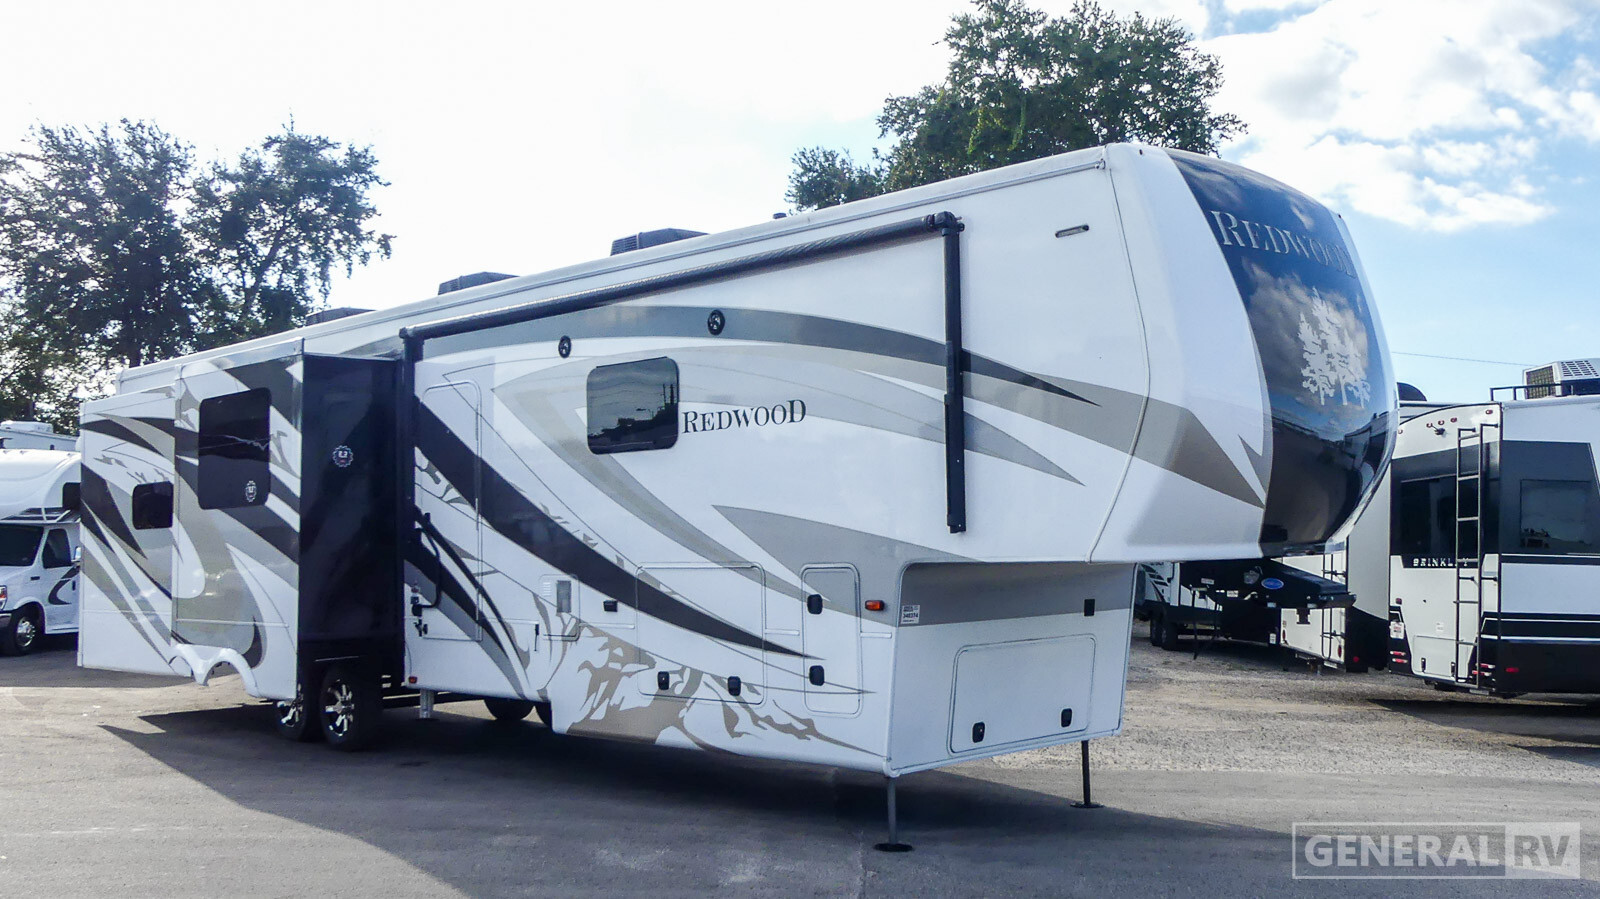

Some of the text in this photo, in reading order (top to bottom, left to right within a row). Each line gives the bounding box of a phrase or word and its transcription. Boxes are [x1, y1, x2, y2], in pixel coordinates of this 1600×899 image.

[1210, 210, 1357, 279] REDWOOD
[682, 399, 806, 433] REDWOOD
[1413, 558, 1469, 567] BRINKLY
